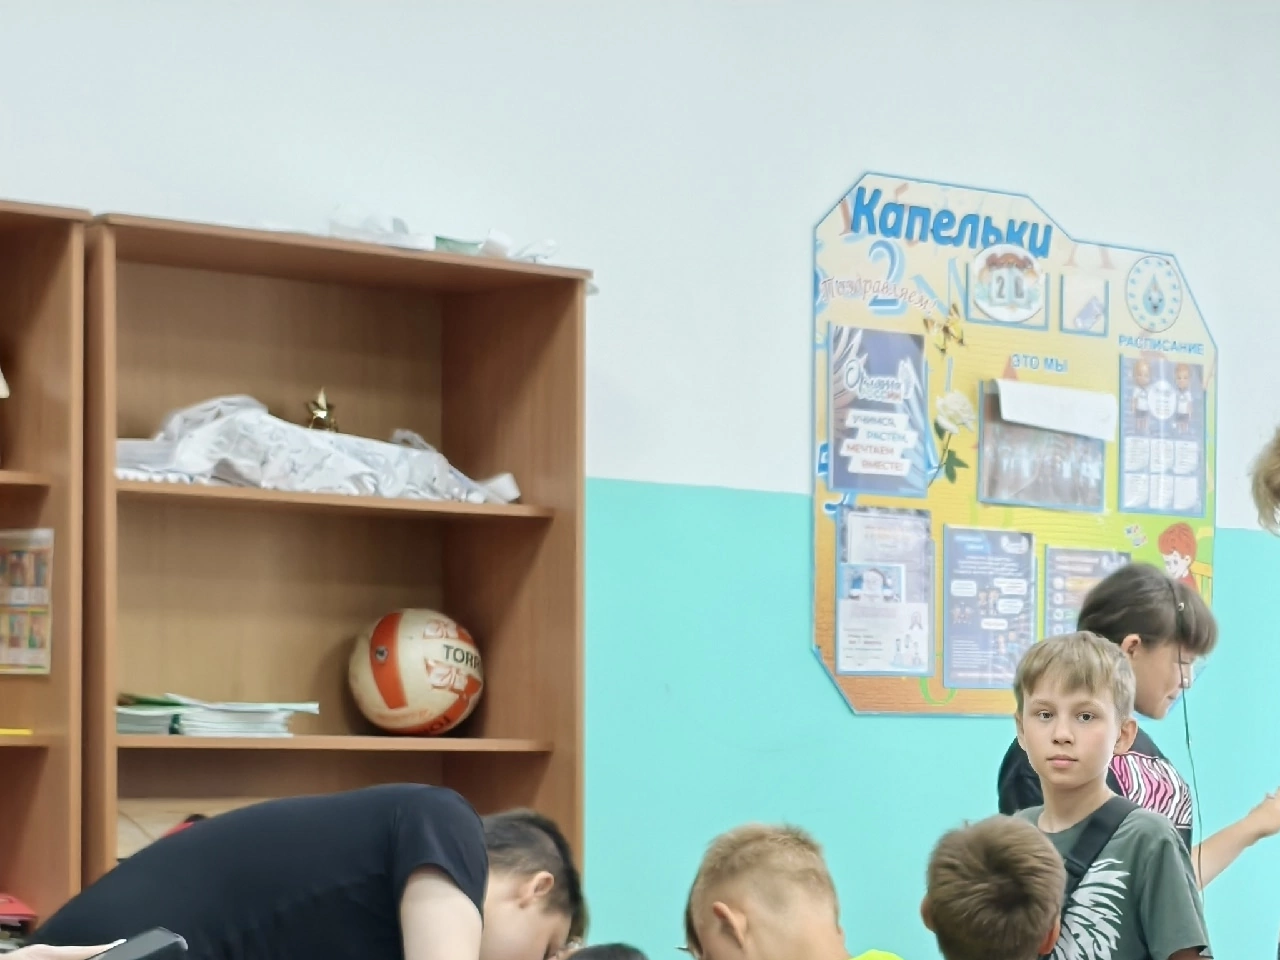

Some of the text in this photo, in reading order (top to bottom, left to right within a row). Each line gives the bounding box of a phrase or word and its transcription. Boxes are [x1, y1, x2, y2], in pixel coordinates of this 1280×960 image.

[851, 186, 1052, 258] Капельки
[1118, 335, 1204, 356] РАСПИСАНИЕ
[1011, 353, 1069, 372] ЭТО МЫ
